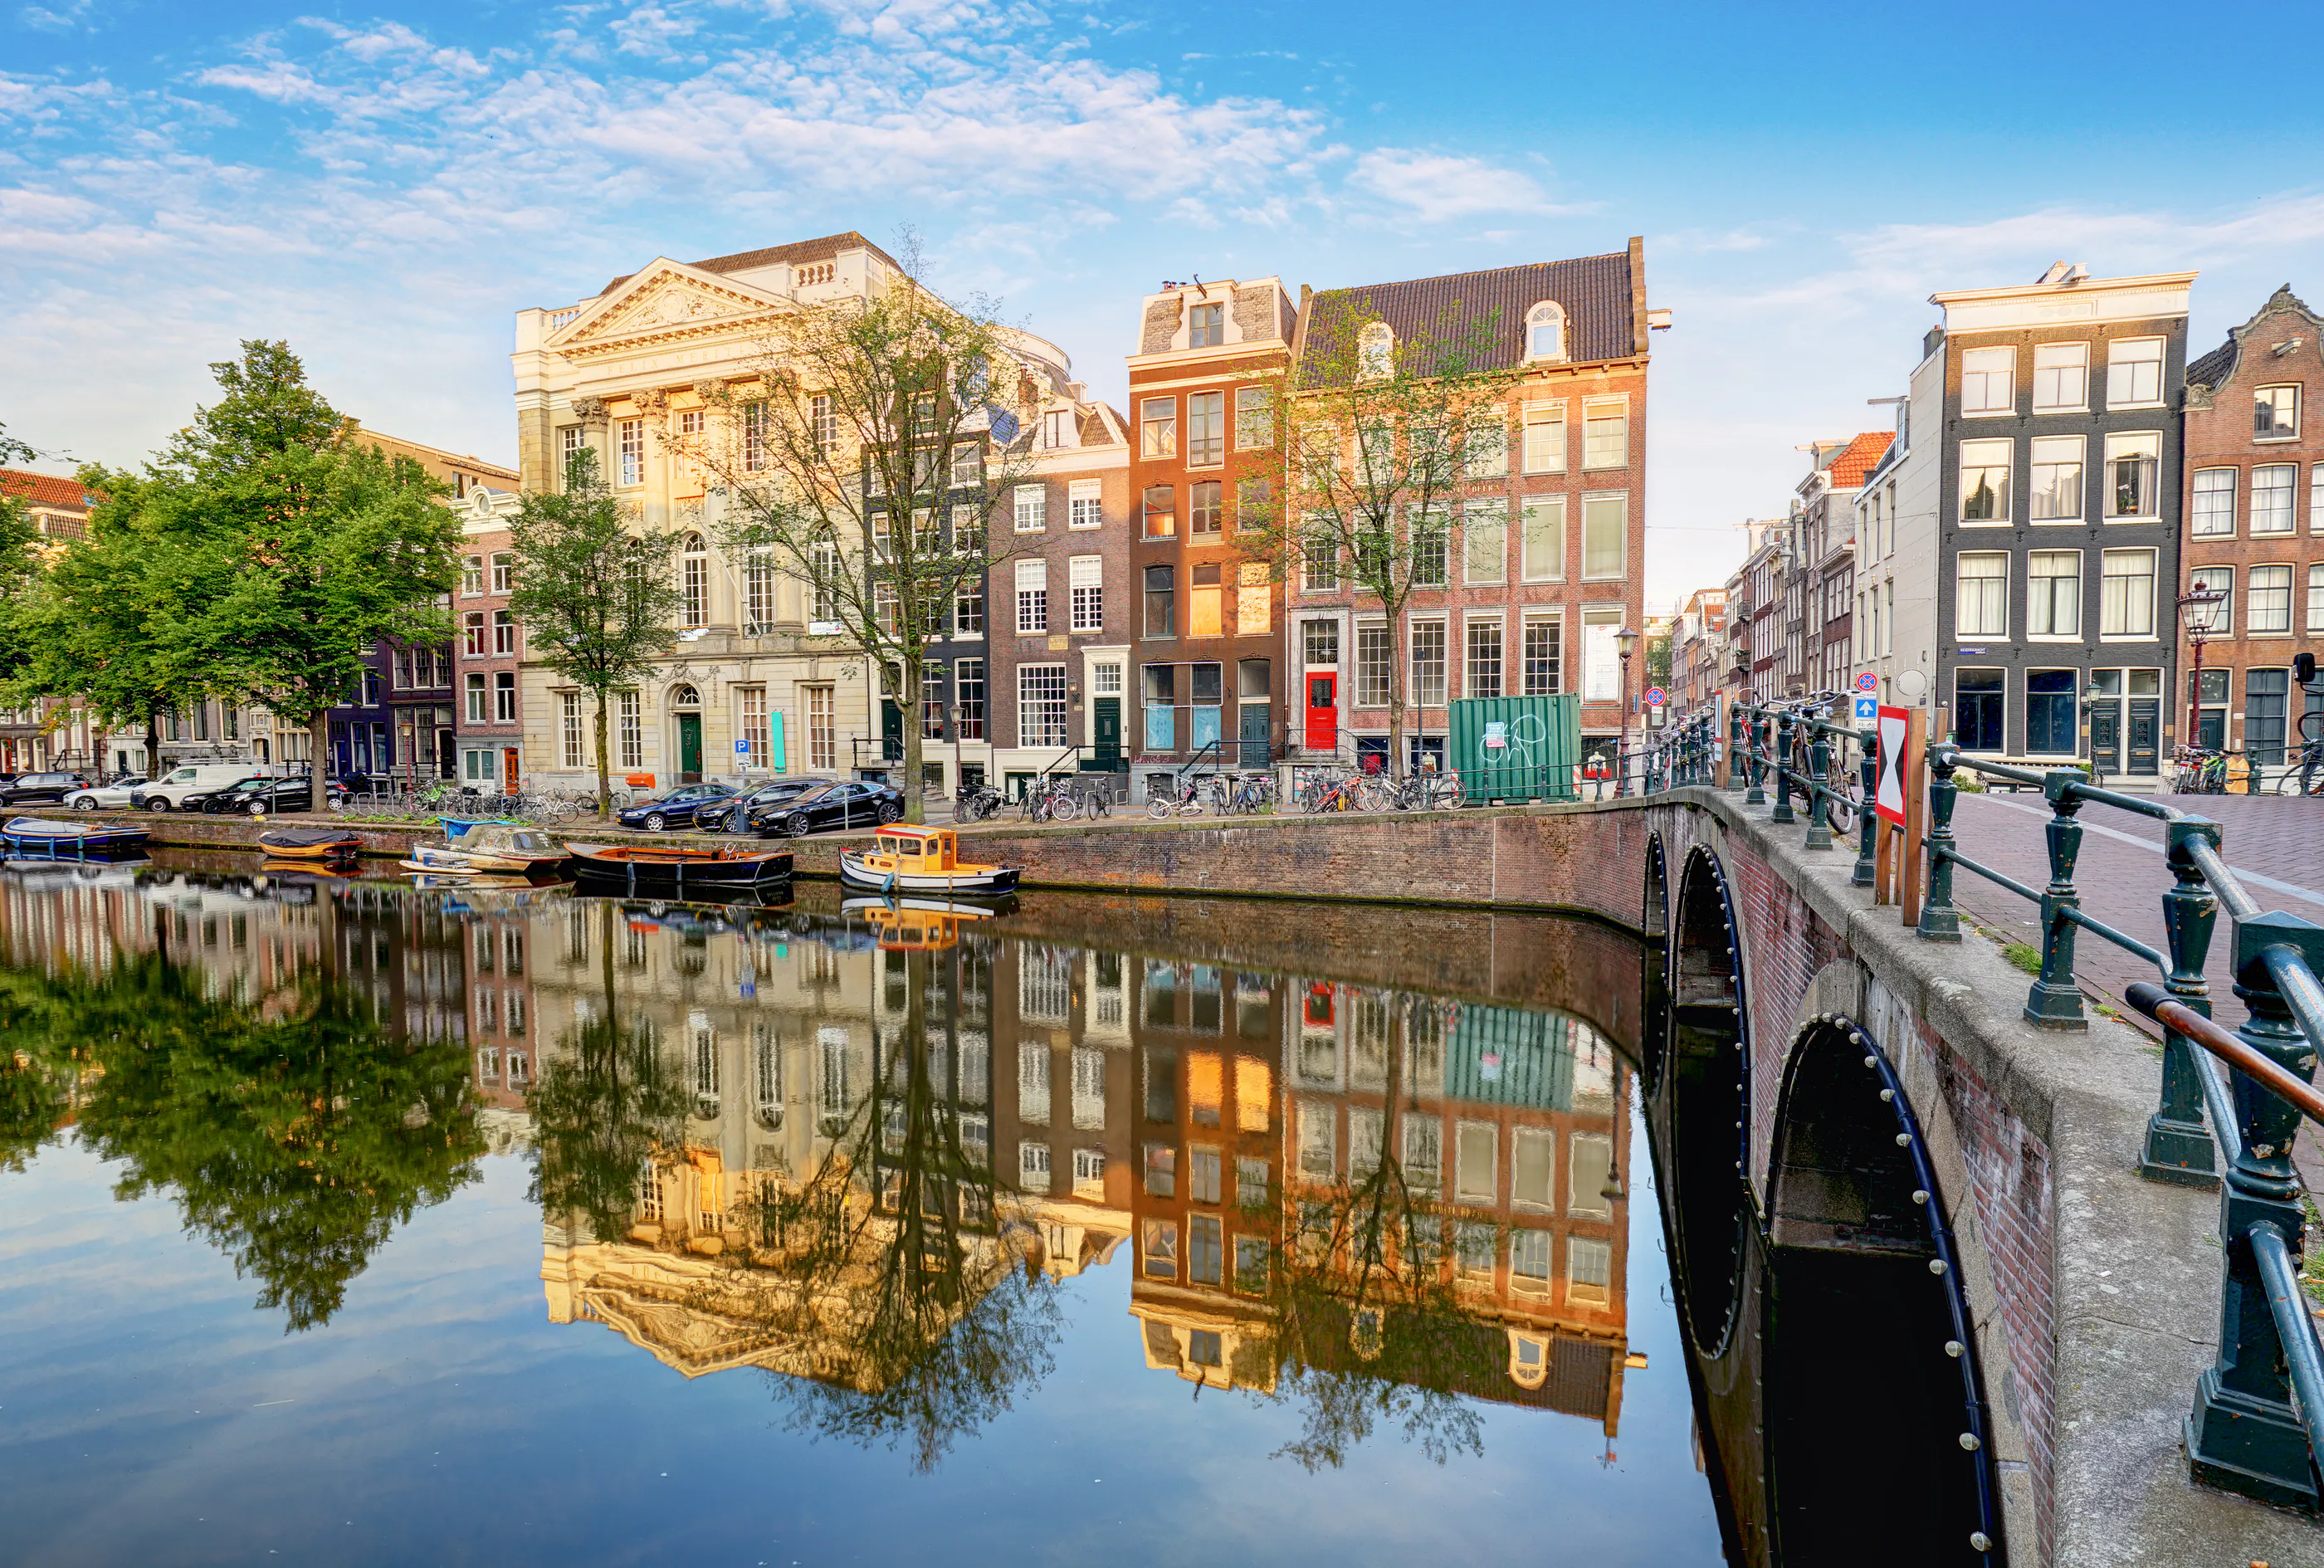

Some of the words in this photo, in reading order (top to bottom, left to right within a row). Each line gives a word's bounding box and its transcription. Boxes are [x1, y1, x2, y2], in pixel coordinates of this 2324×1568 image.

[607, 358, 659, 375] FELIX
[676, 344, 755, 364] MERITIS
[1472, 484, 1493, 493] BEER
[738, 741, 746, 752] P
